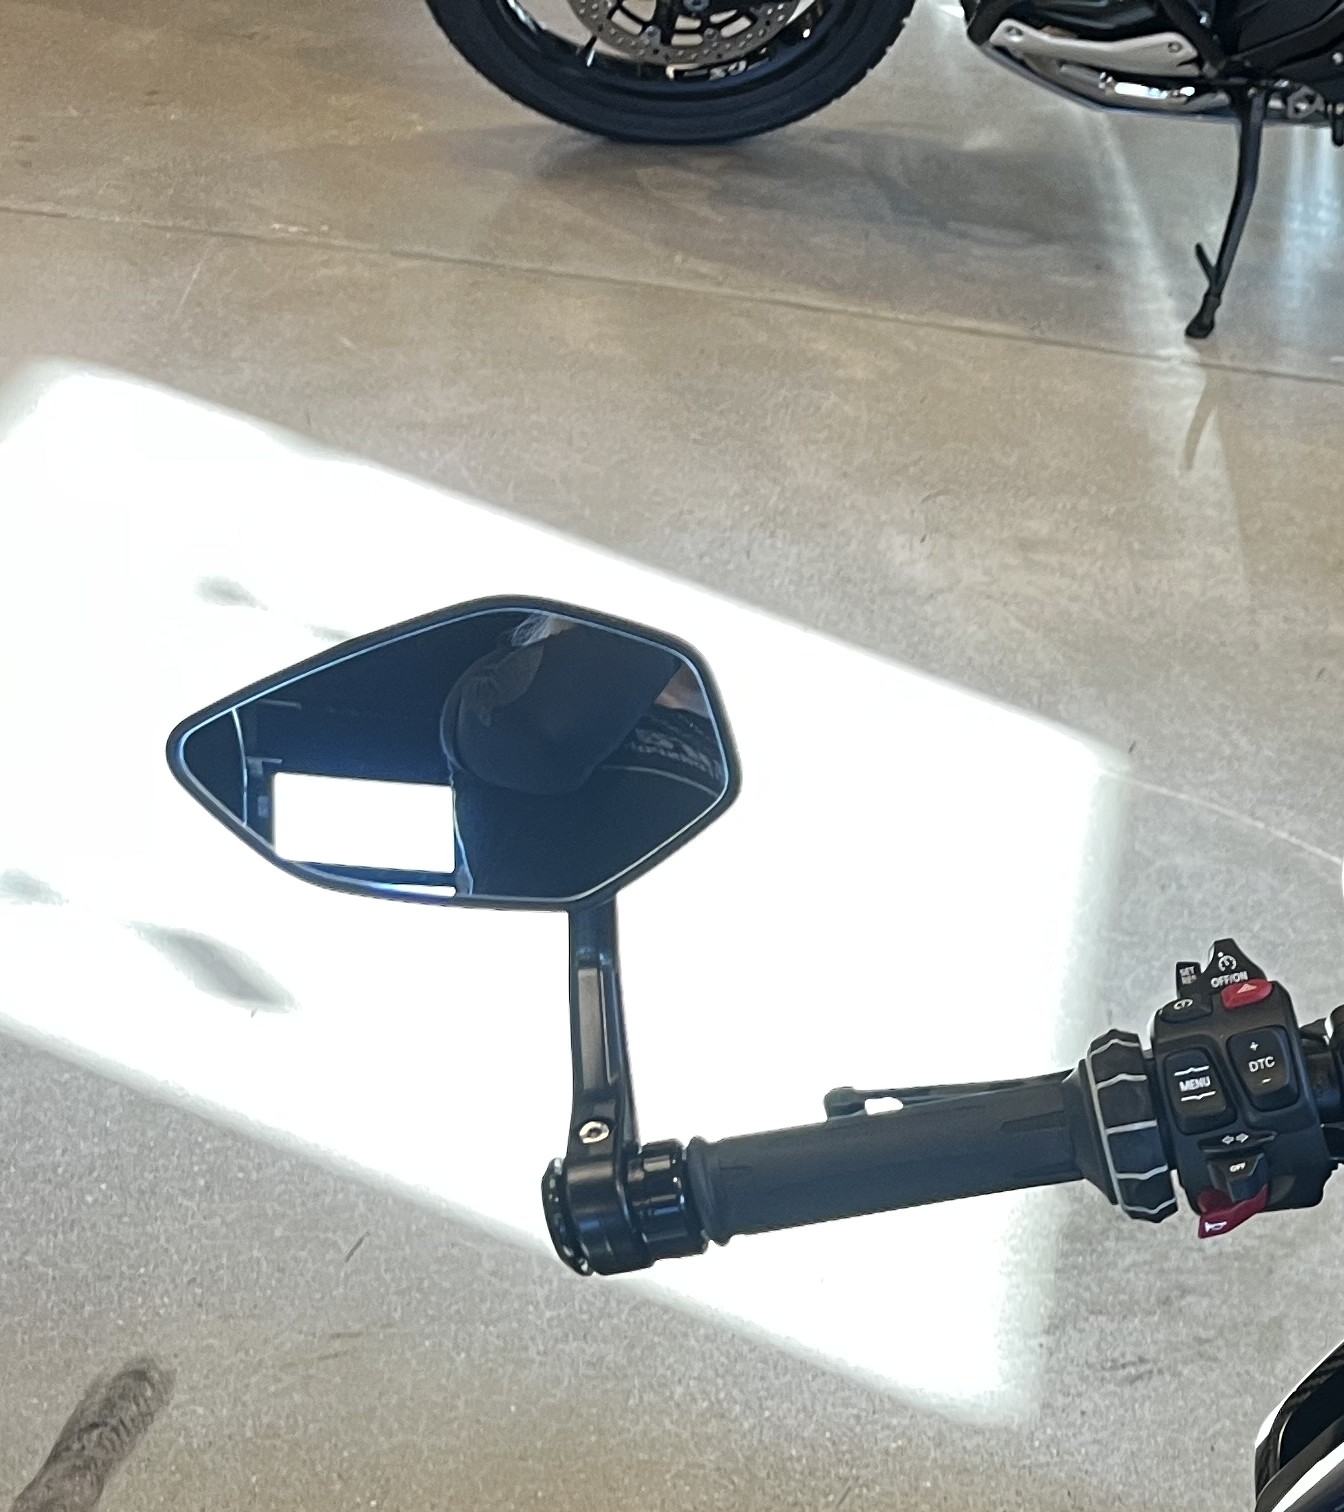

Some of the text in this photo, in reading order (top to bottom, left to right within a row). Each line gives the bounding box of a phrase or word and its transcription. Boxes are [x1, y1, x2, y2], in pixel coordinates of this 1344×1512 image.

[1211, 971, 1248, 988] OFF/ON
[1248, 1056, 1275, 1072] DTC
[1179, 1076, 1211, 1092] MENU
